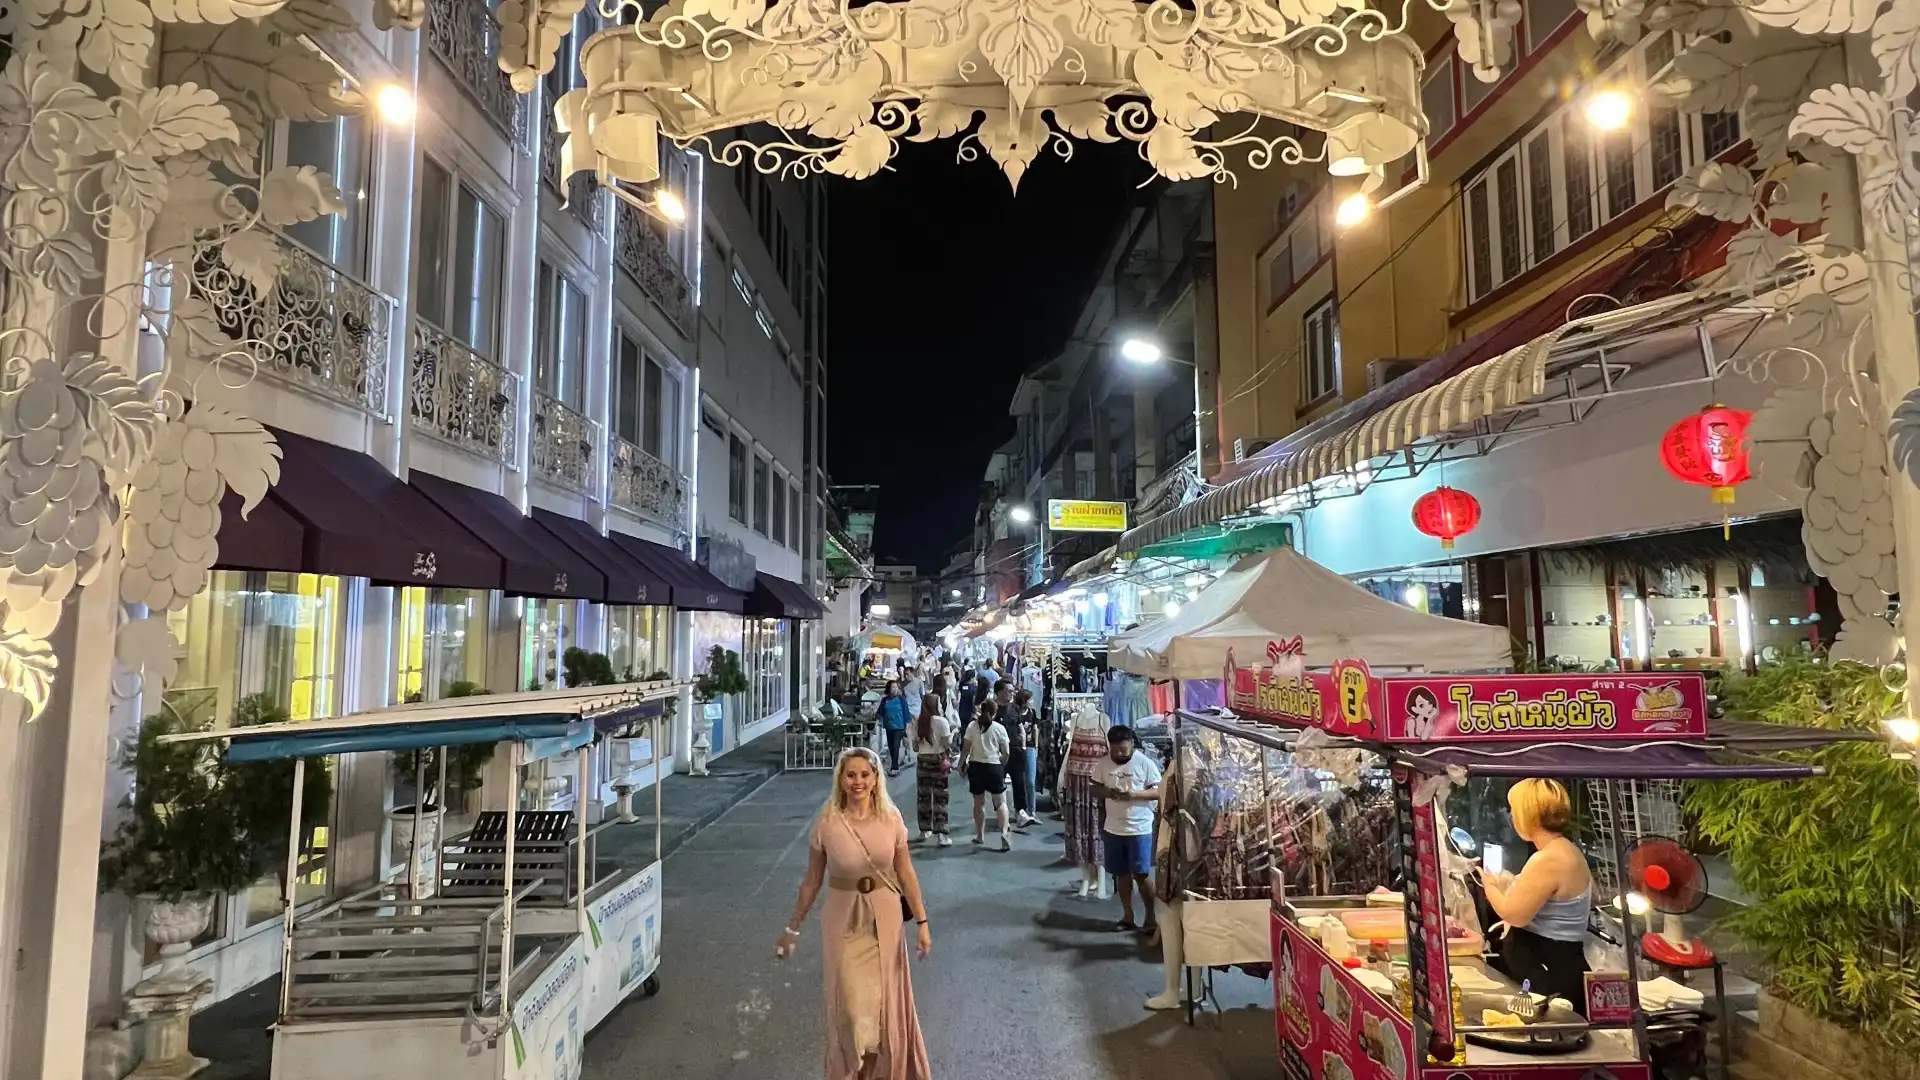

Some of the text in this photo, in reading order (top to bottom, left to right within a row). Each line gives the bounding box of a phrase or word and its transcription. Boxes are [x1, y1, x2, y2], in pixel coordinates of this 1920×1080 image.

[1344, 670, 1361, 684] สาขา
[1591, 680, 1625, 689] สาขา 2
[1347, 687, 1356, 716] 2
[1449, 684, 1616, 733] โรตีหนีผัว
